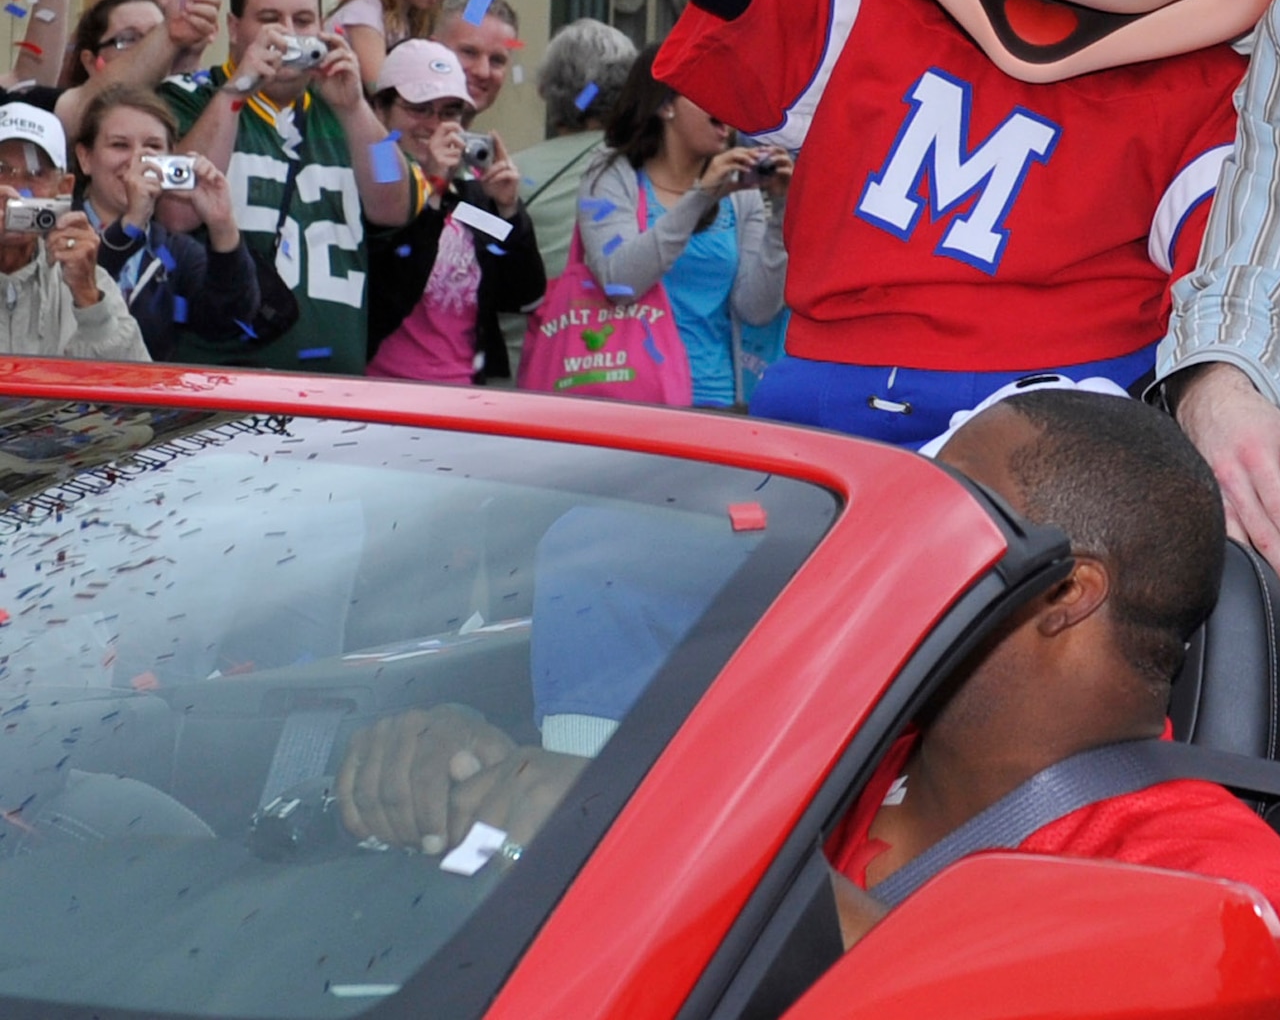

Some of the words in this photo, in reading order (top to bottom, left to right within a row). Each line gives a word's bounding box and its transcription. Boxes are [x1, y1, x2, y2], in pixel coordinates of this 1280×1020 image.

[0, 118, 45, 134] CKERS
[853, 65, 1064, 277] M
[226, 151, 366, 310] 52
[540, 308, 591, 338] WALT
[563, 350, 628, 372] WORLD
